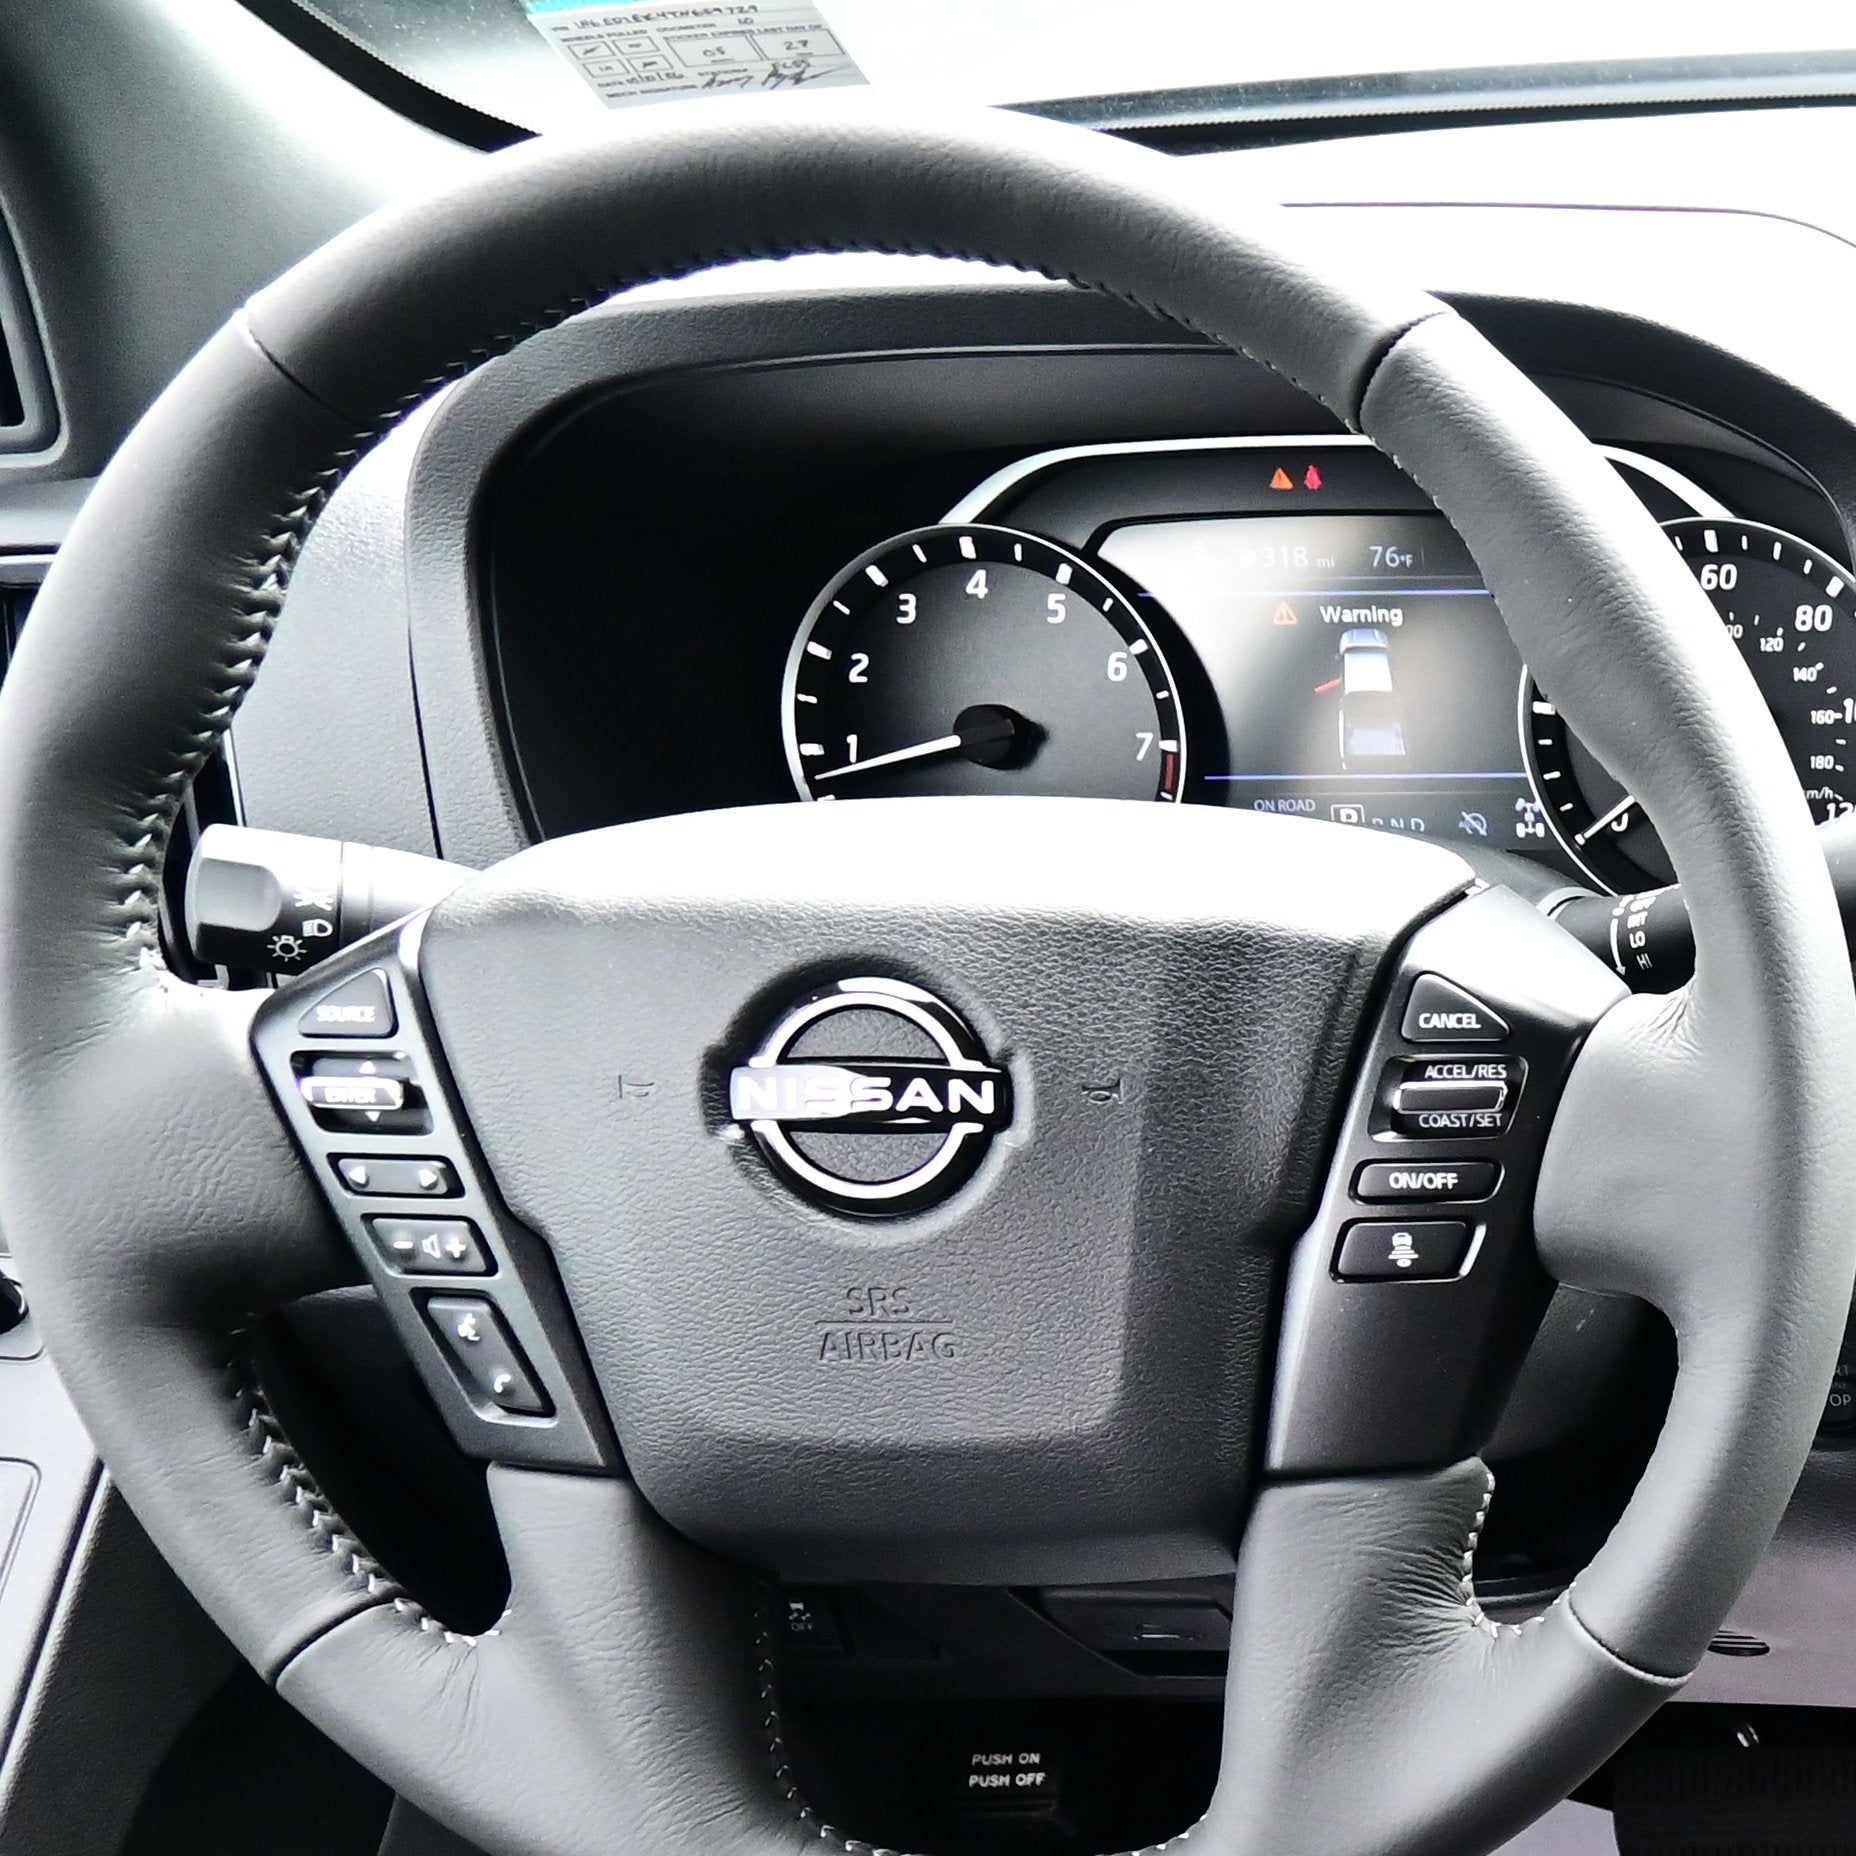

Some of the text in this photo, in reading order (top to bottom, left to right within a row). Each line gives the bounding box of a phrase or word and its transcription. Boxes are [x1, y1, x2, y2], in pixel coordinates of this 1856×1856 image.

[965, 569, 988, 599] 4
[1700, 563, 1738, 591] 60
[896, 593, 917, 624] 3
[1046, 593, 1067, 624] 5
[1319, 605, 1404, 627] Warning
[1794, 605, 1833, 632] 80
[1760, 637, 1784, 652] 120
[848, 653, 870, 683] 2
[1107, 651, 1128, 682] 6
[1793, 666, 1817, 682] 140
[1810, 709, 1835, 725] 160
[846, 734, 858, 763] 1
[1135, 731, 1154, 761] 7
[1810, 754, 1835, 770] 180
[1253, 798, 1317, 812] ON ROAD
[1629, 930, 1646, 949] LO
[1418, 1012, 1482, 1030] CANCEL
[1424, 1063, 1508, 1080] ACCEL/RES
[737, 1076, 995, 1115] NISSAN
[1418, 1113, 1503, 1128] COAST/SET
[1388, 1172, 1459, 1190] ON/OFF
[846, 1286, 910, 1316] SRS
[819, 1332, 955, 1361] AIRBAG
[972, 1752, 1041, 1767] PUSH ON
[968, 1772, 1046, 1788] PUSH OFF
